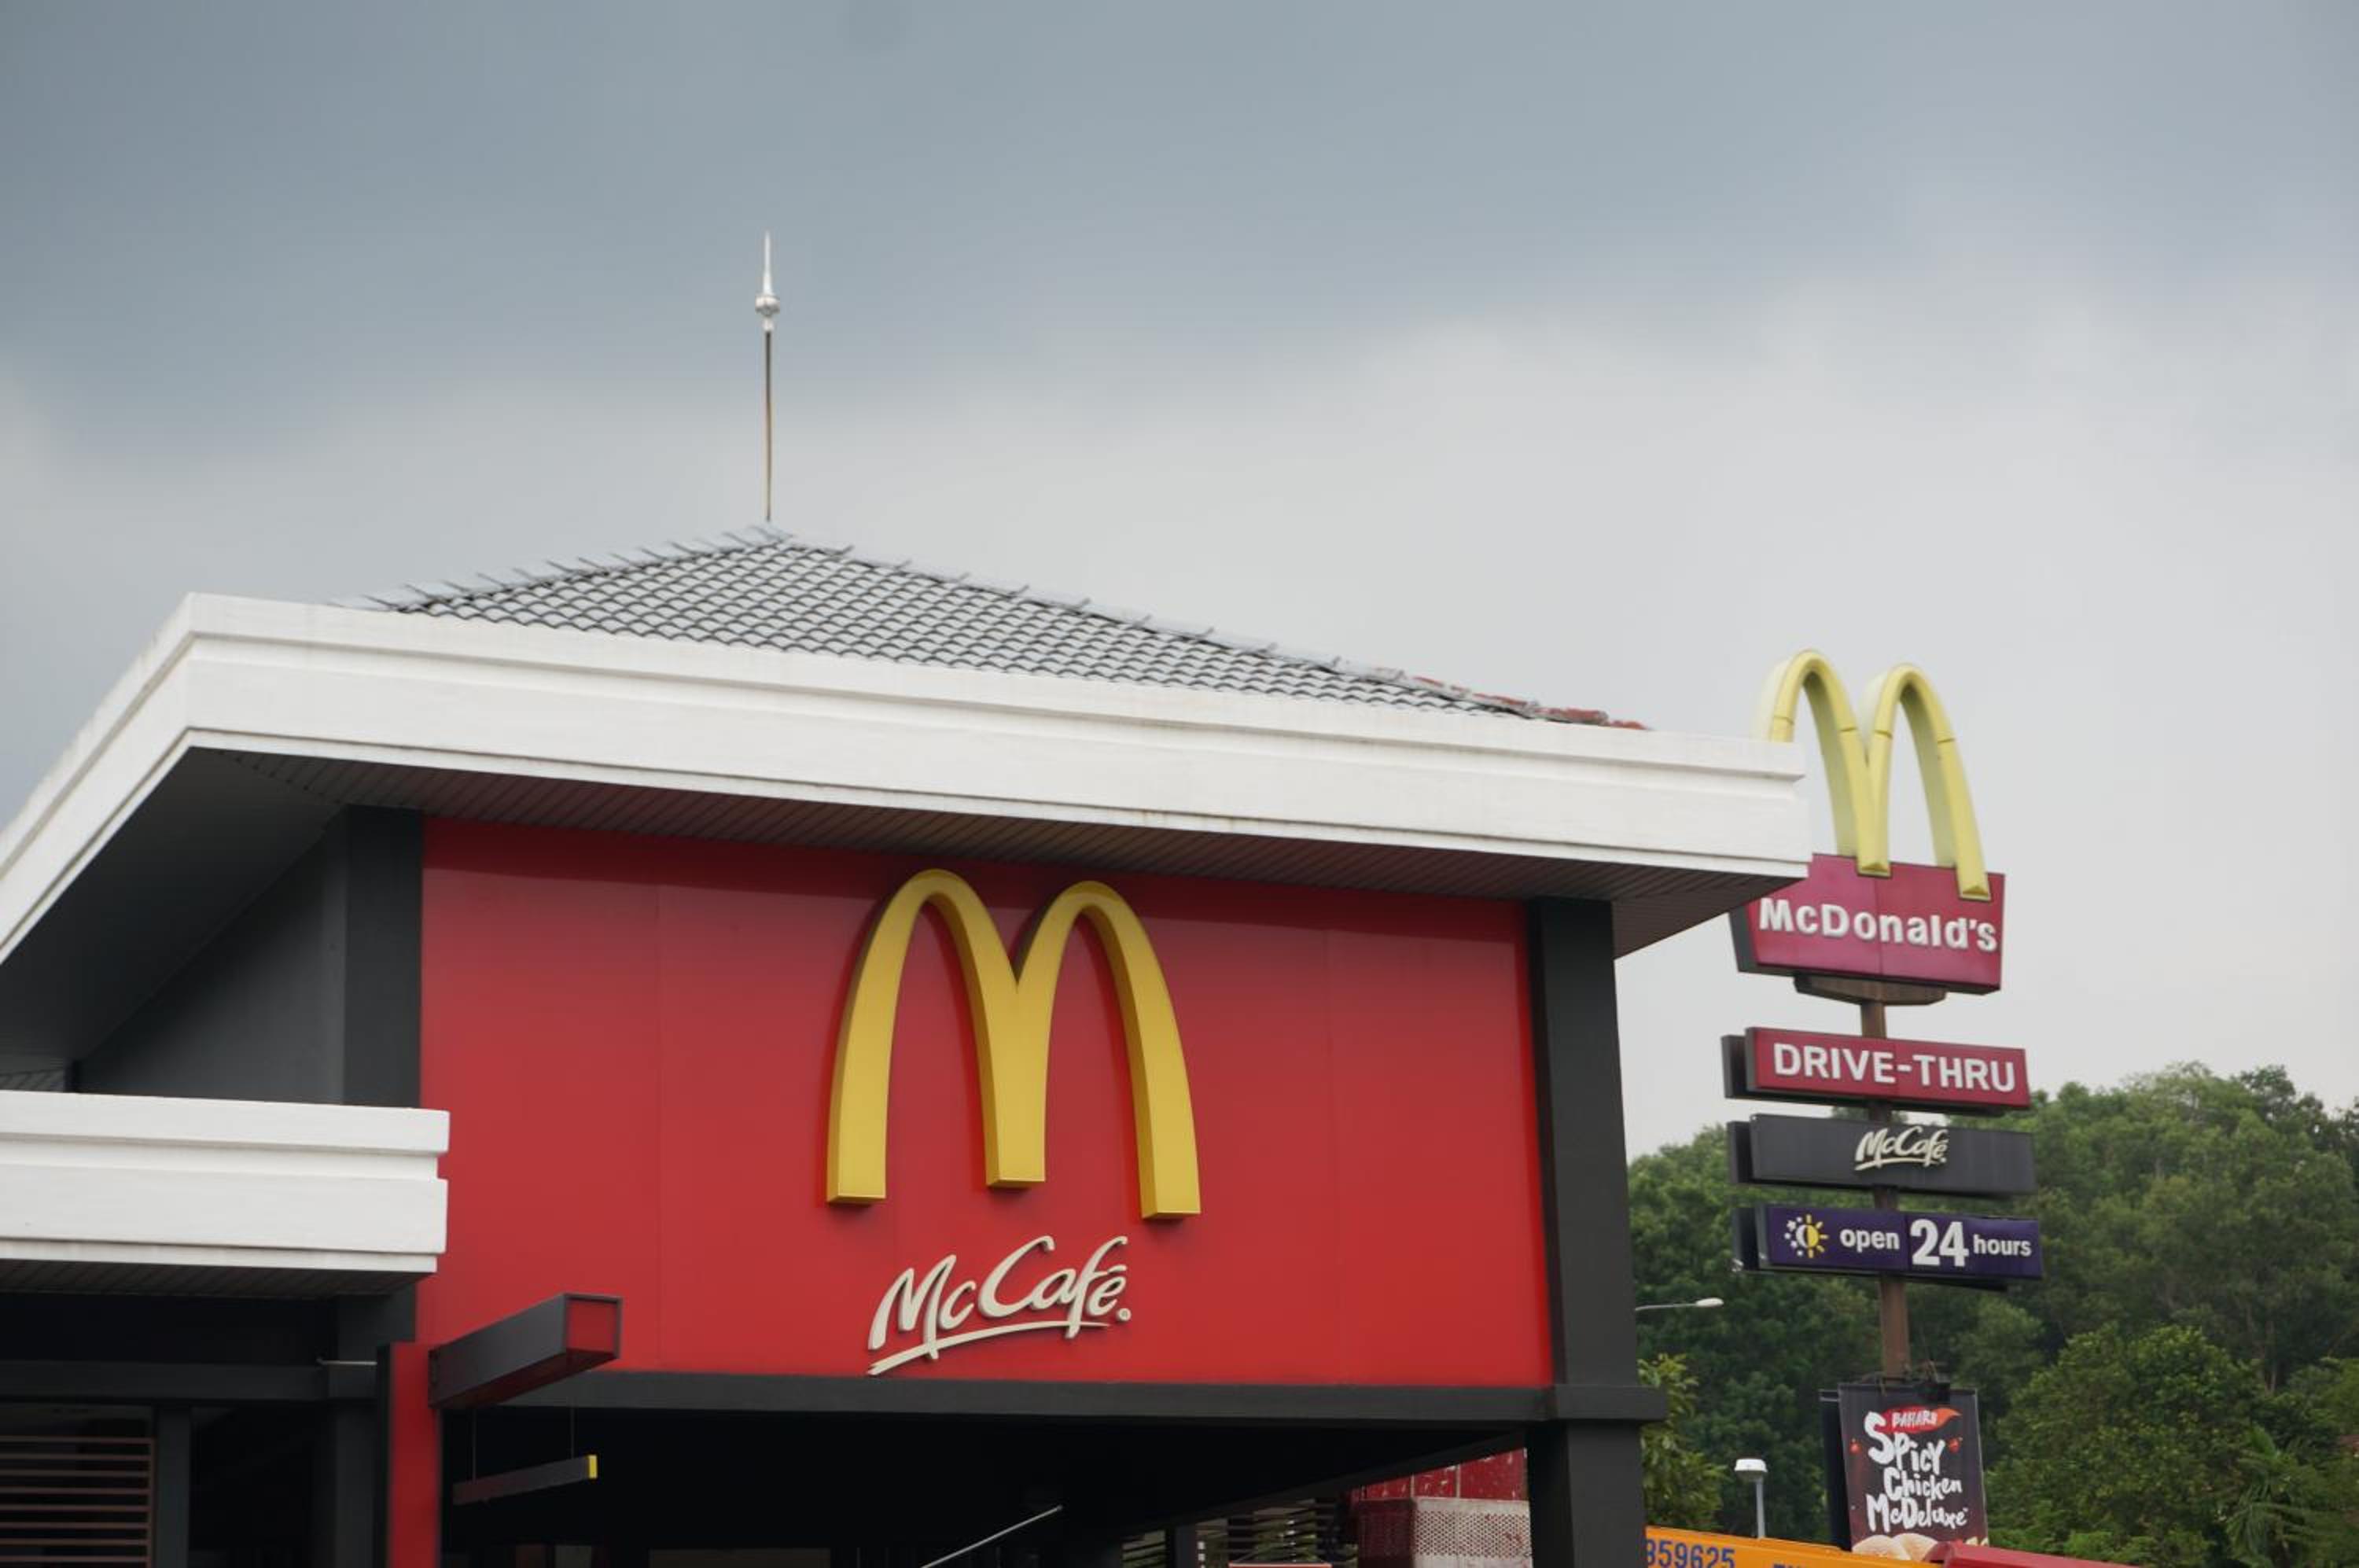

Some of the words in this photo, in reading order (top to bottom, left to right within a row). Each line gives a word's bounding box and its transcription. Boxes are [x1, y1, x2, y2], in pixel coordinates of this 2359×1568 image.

[1758, 896, 1998, 952] McDonald's
[1773, 1043, 2015, 1092] DRIVE-THRU
[1839, 1228, 1900, 1253] open
[1910, 1218, 1970, 1267] 24
[1972, 1233, 2033, 1257] hours
[1883, 1466, 1963, 1501] Chicken
[1865, 1493, 1968, 1533] McDeluxe
